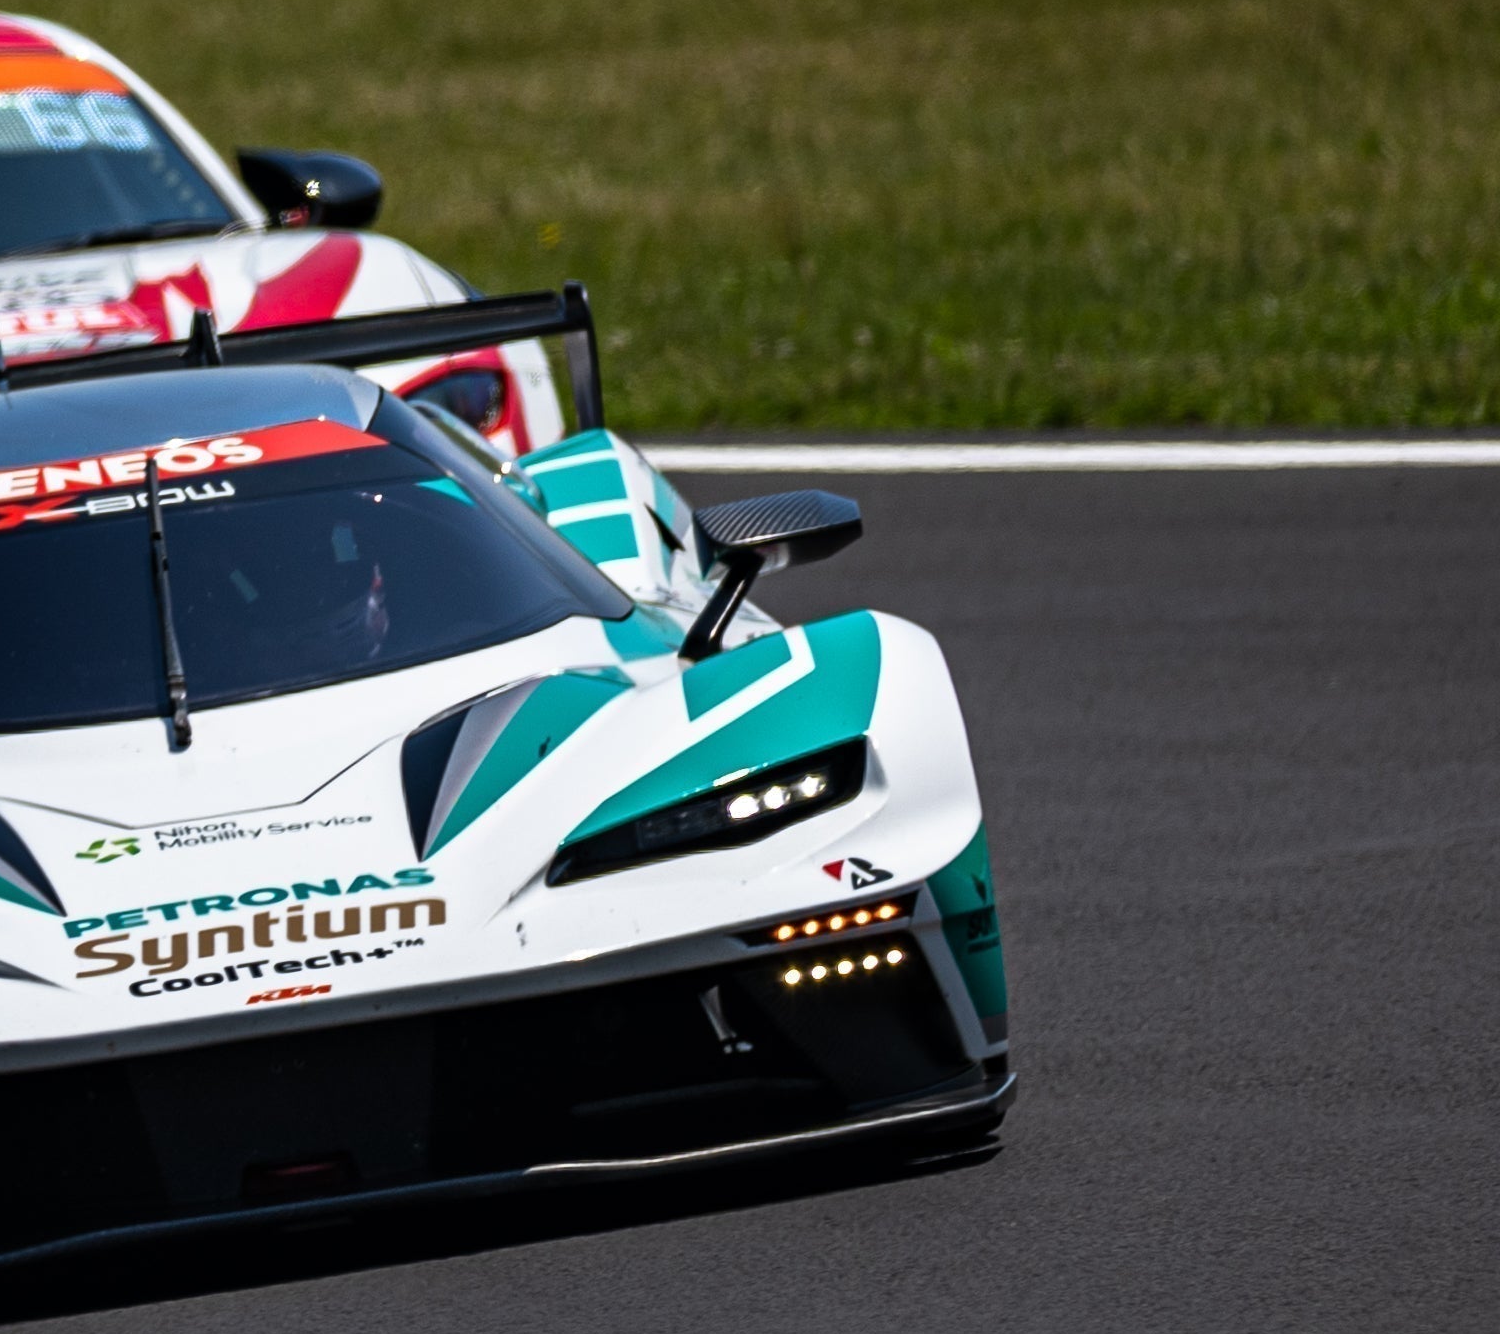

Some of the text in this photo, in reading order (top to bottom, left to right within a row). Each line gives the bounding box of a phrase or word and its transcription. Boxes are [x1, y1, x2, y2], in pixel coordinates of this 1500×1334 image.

[14, 87, 153, 152] 66
[154, 820, 238, 840] Nihon
[158, 815, 373, 851] Mobility Service
[62, 867, 436, 939] PETRONAS
[73, 895, 448, 979] Syntium
[245, 983, 333, 1006] KTM
